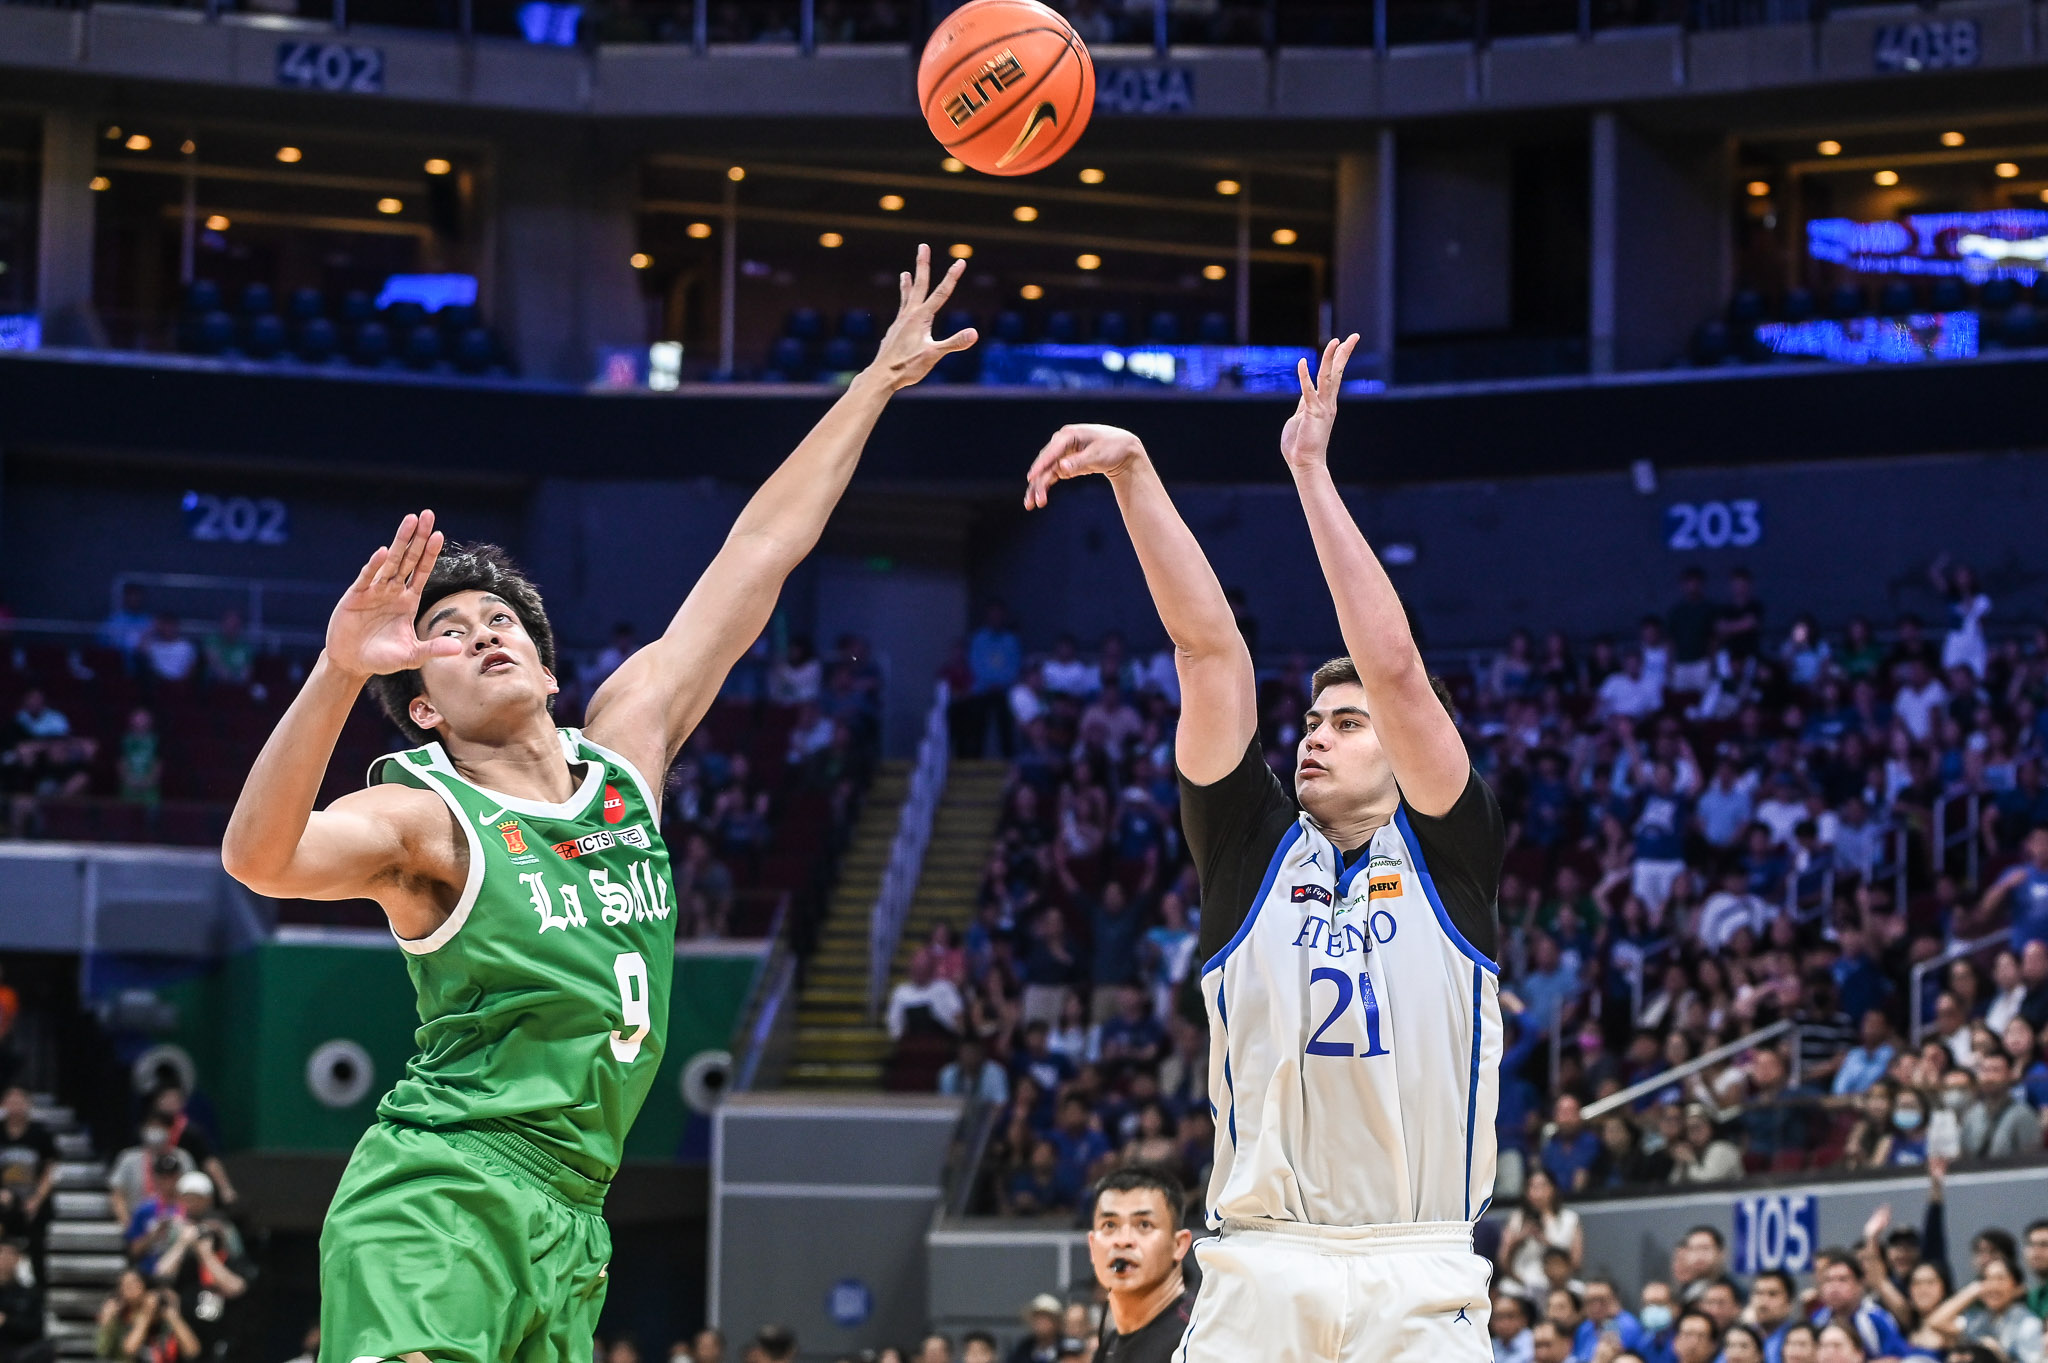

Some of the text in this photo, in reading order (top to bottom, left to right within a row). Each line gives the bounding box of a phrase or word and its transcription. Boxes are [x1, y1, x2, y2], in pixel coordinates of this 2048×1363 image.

[281, 44, 382, 92] 402
[940, 47, 1026, 130] ELITE
[192, 494, 286, 544] 202
[1668, 500, 1761, 549] 203
[576, 831, 614, 854] ICTSI
[519, 871, 588, 934] La
[609, 951, 650, 1064] 9
[1305, 967, 1390, 1058] 21
[1743, 1197, 1809, 1272] 105
